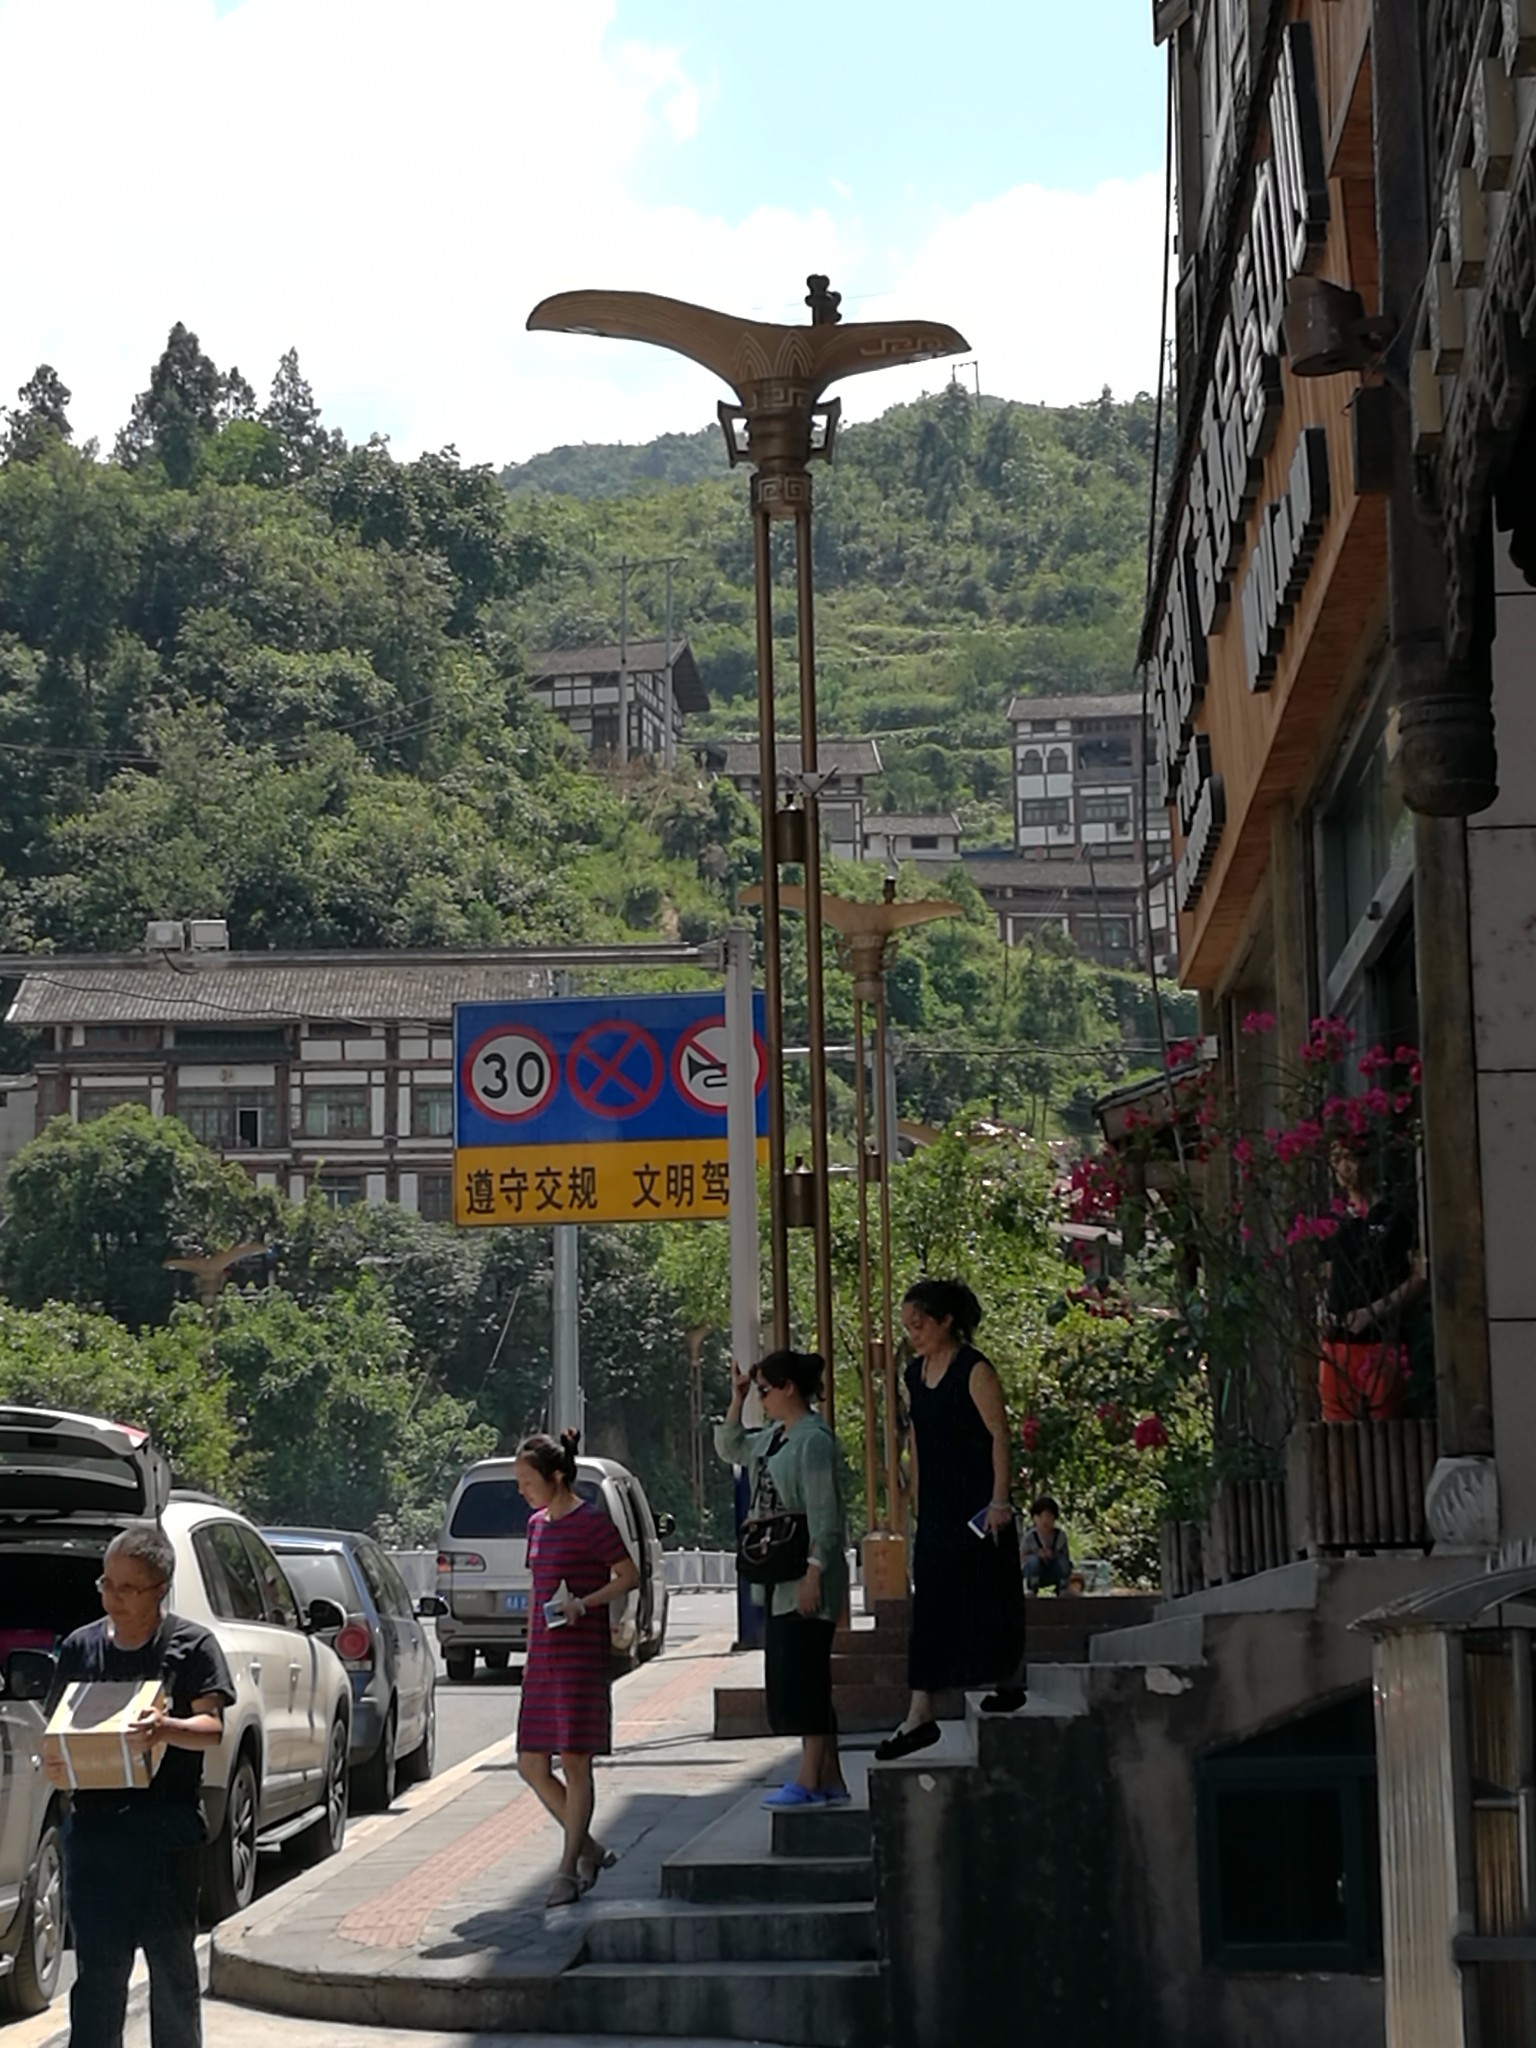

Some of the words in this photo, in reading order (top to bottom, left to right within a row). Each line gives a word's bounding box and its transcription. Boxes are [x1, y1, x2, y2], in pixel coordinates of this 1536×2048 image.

[481, 1051, 545, 1099] 30
[465, 1165, 598, 1215] 遵守交规
[632, 1160, 729, 1209] 文明驾
